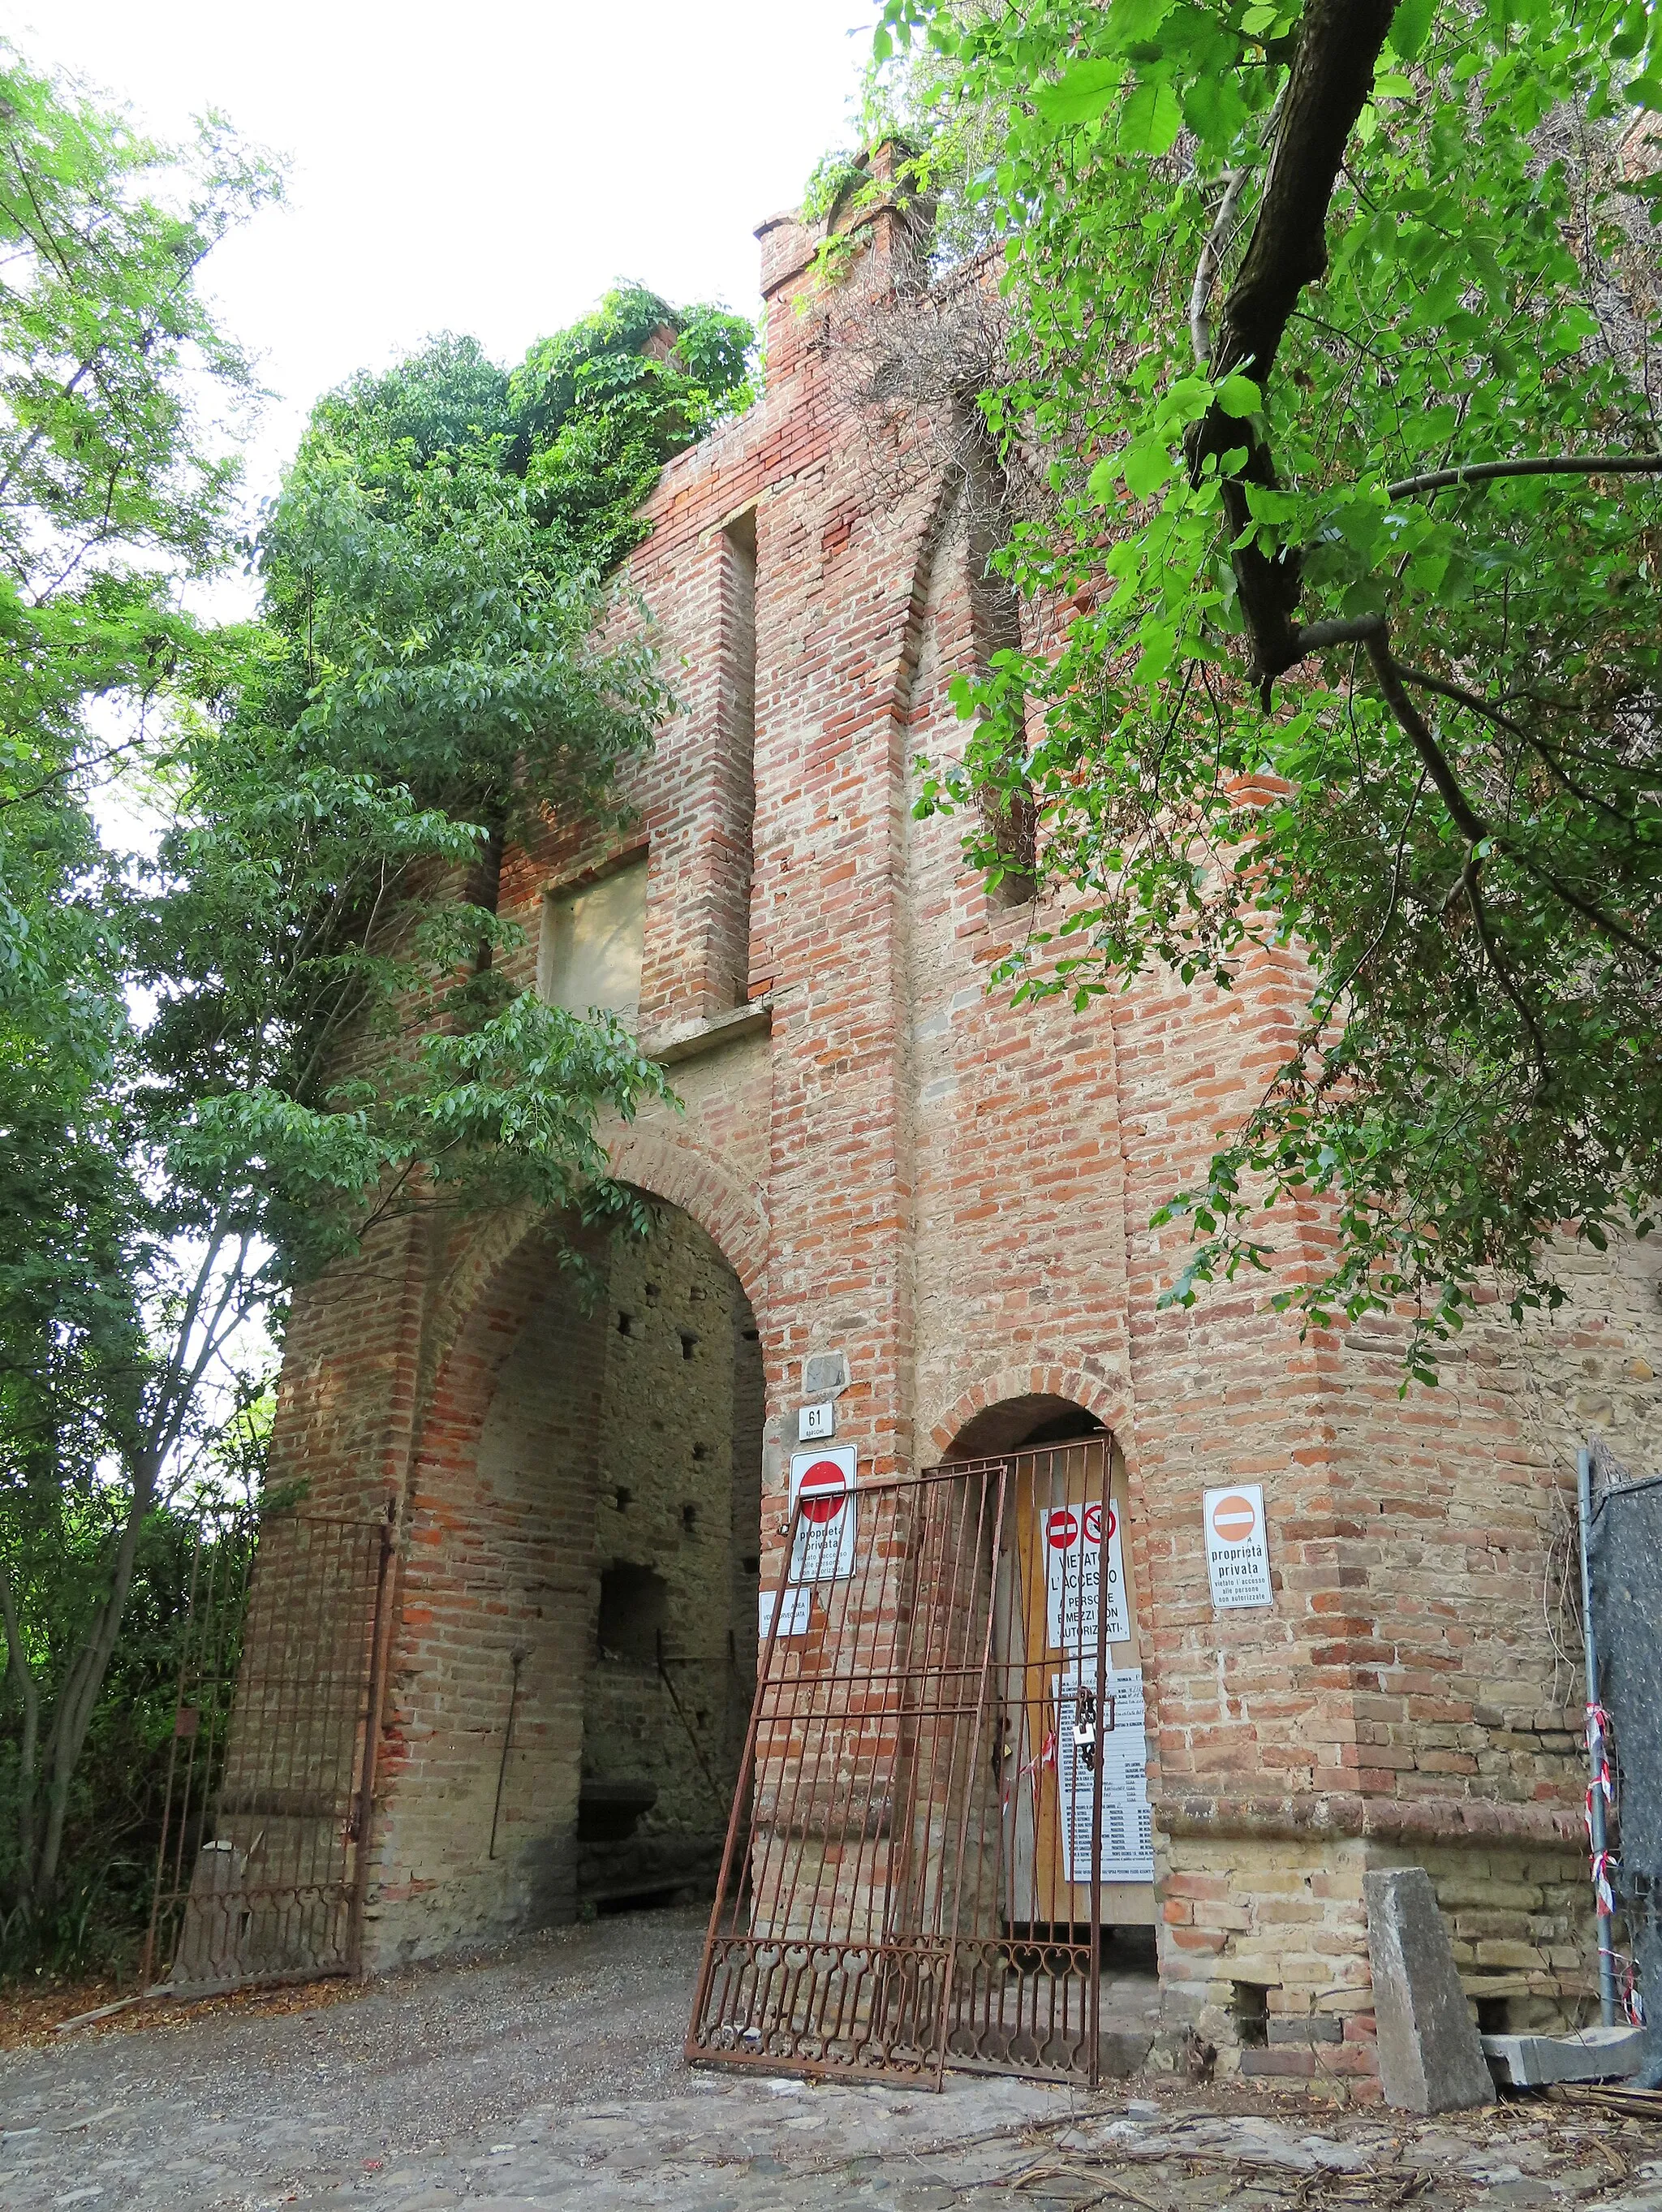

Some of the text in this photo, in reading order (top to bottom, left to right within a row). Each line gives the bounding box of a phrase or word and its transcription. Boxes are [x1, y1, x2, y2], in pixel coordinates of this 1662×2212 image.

[808, 1409, 820, 1426] 61
[800, 1525, 843, 1542] propretà
[1212, 1545, 1262, 1563] proprietà
[1219, 1563, 1258, 1578] privata
[1052, 1570, 1117, 1590] L'ACCESO
[1236, 1577, 1265, 1585] l'accesso
[1235, 1586, 1259, 1594] persone
[1069, 1593, 1114, 1607] PERSOE
[1231, 1593, 1265, 1602] autorizzate
[1098, 1607, 1118, 1619] ON
